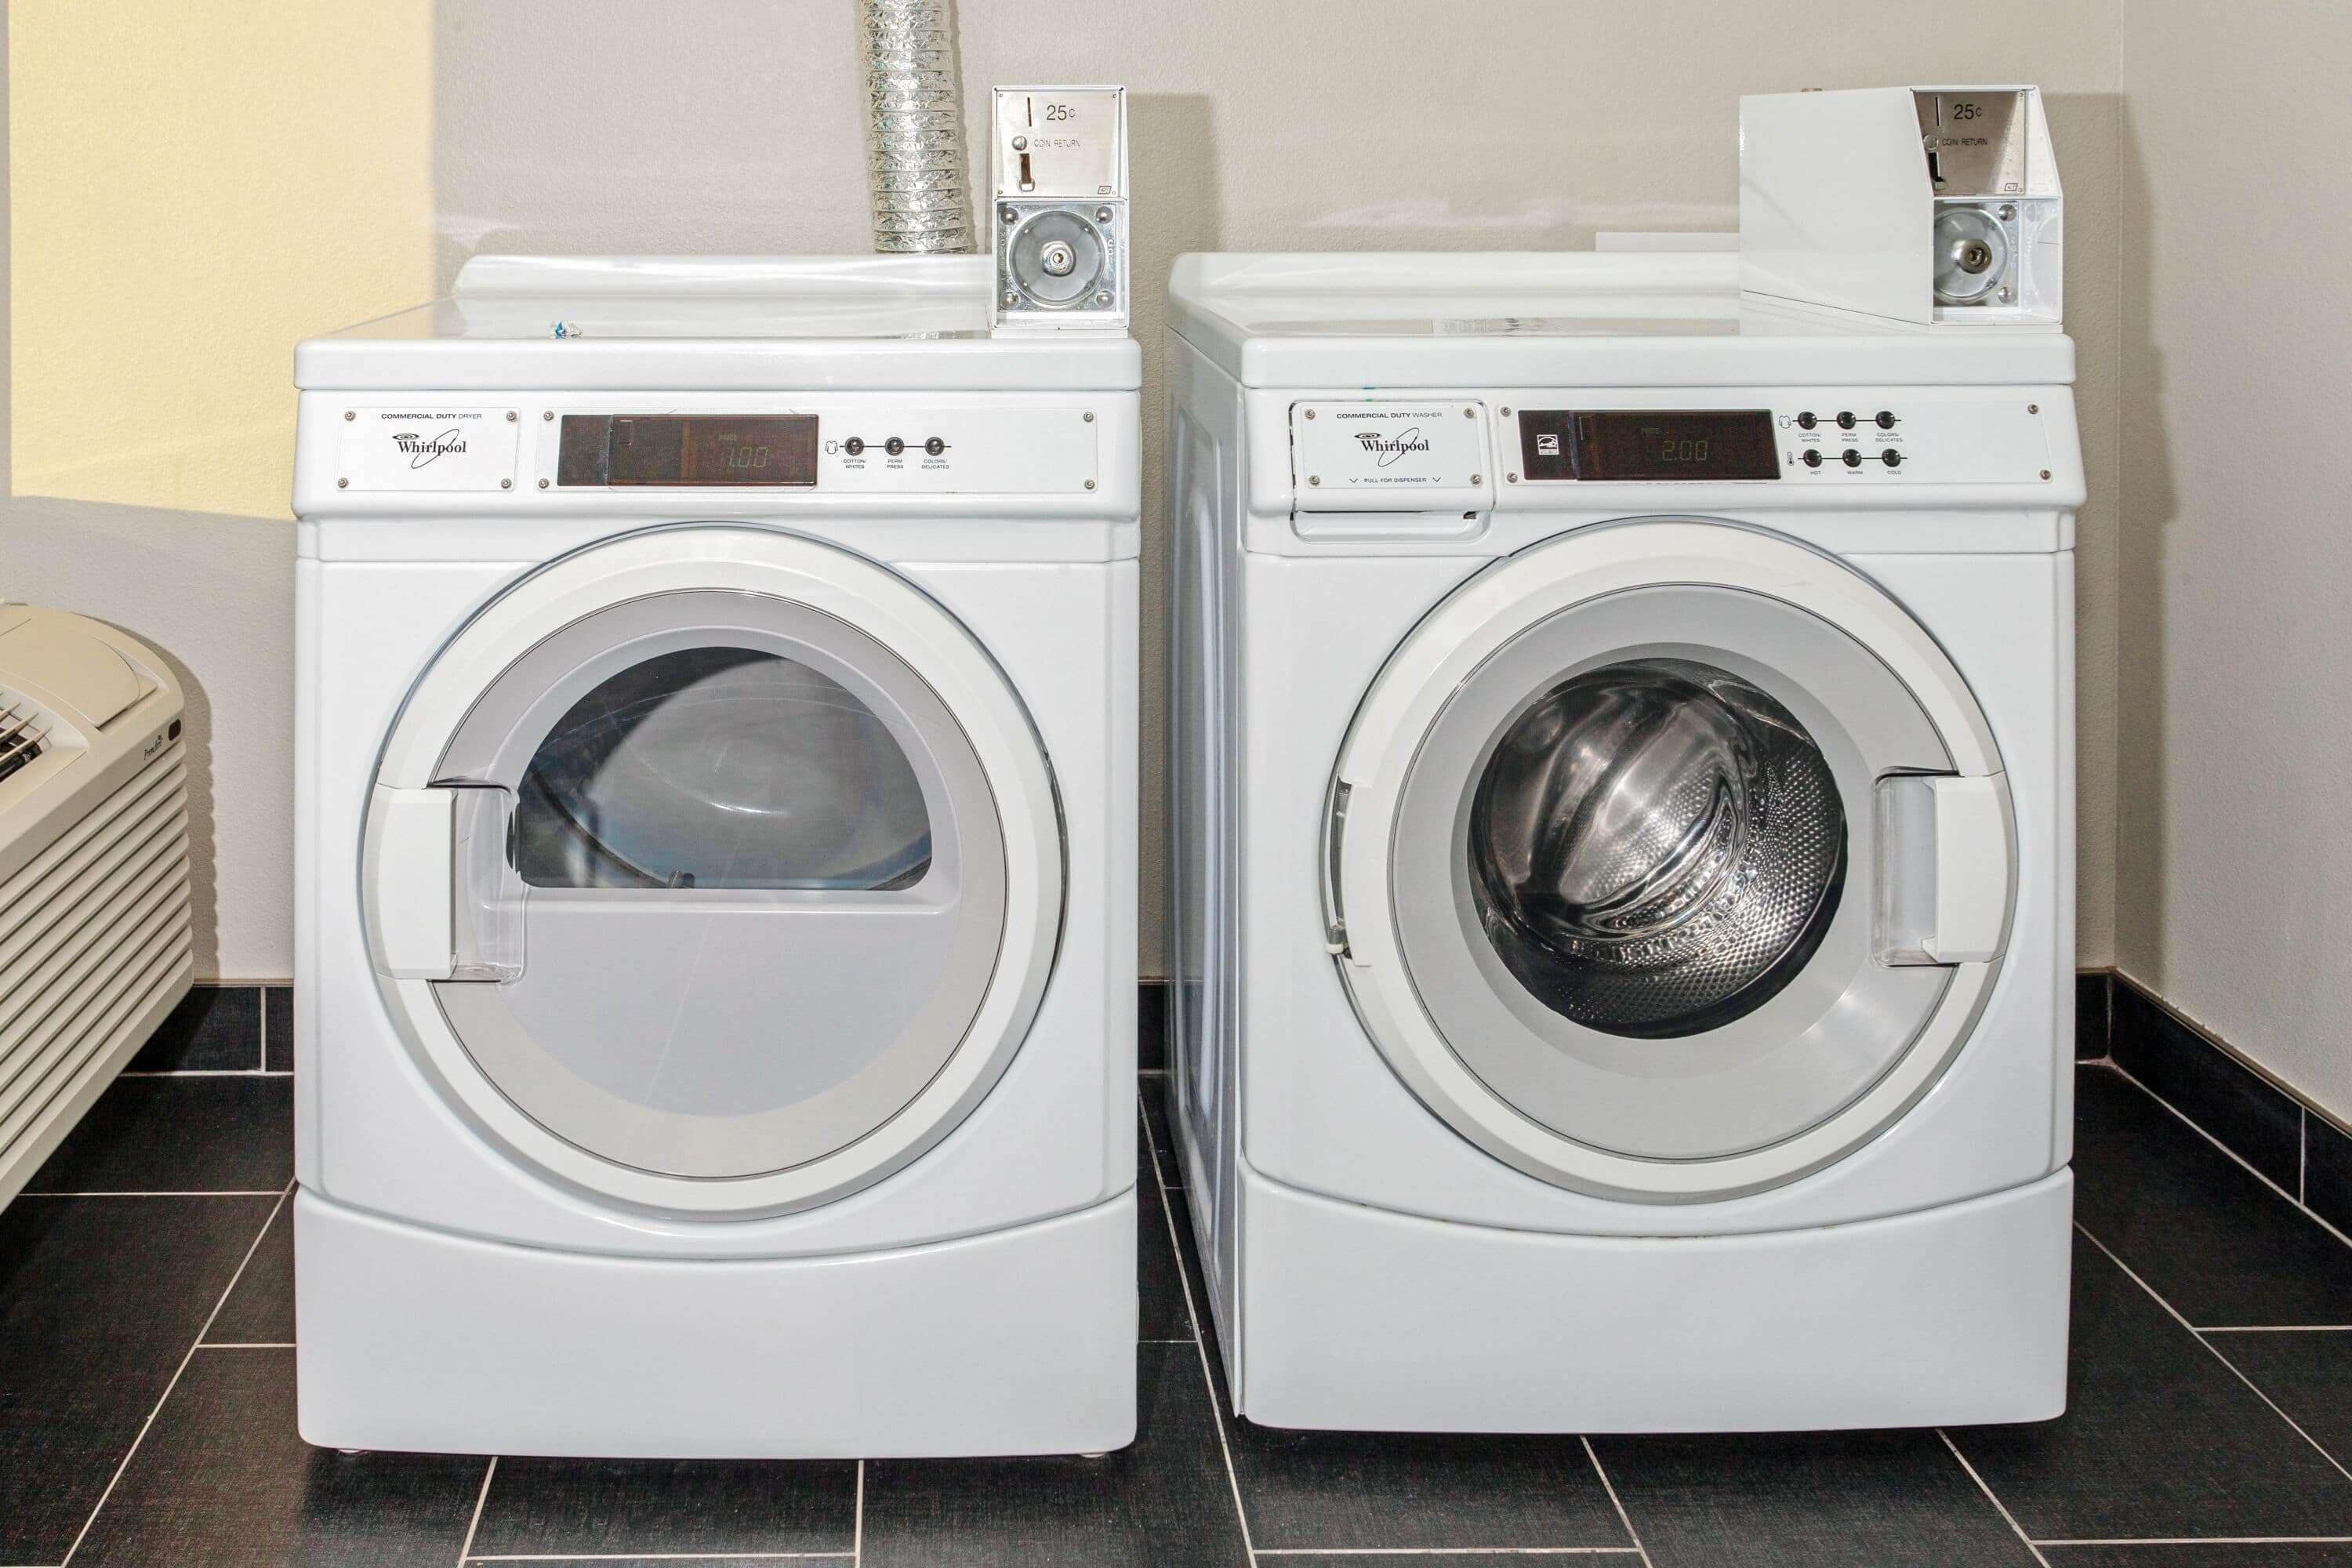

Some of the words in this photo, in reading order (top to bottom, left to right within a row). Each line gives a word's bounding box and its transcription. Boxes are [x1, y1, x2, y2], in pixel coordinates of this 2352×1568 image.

[1033, 139, 1051, 147] COIN
[1054, 139, 1080, 147] RETURN
[397, 441, 467, 456] Whirlpool
[1360, 439, 1430, 455] Whirlpool
